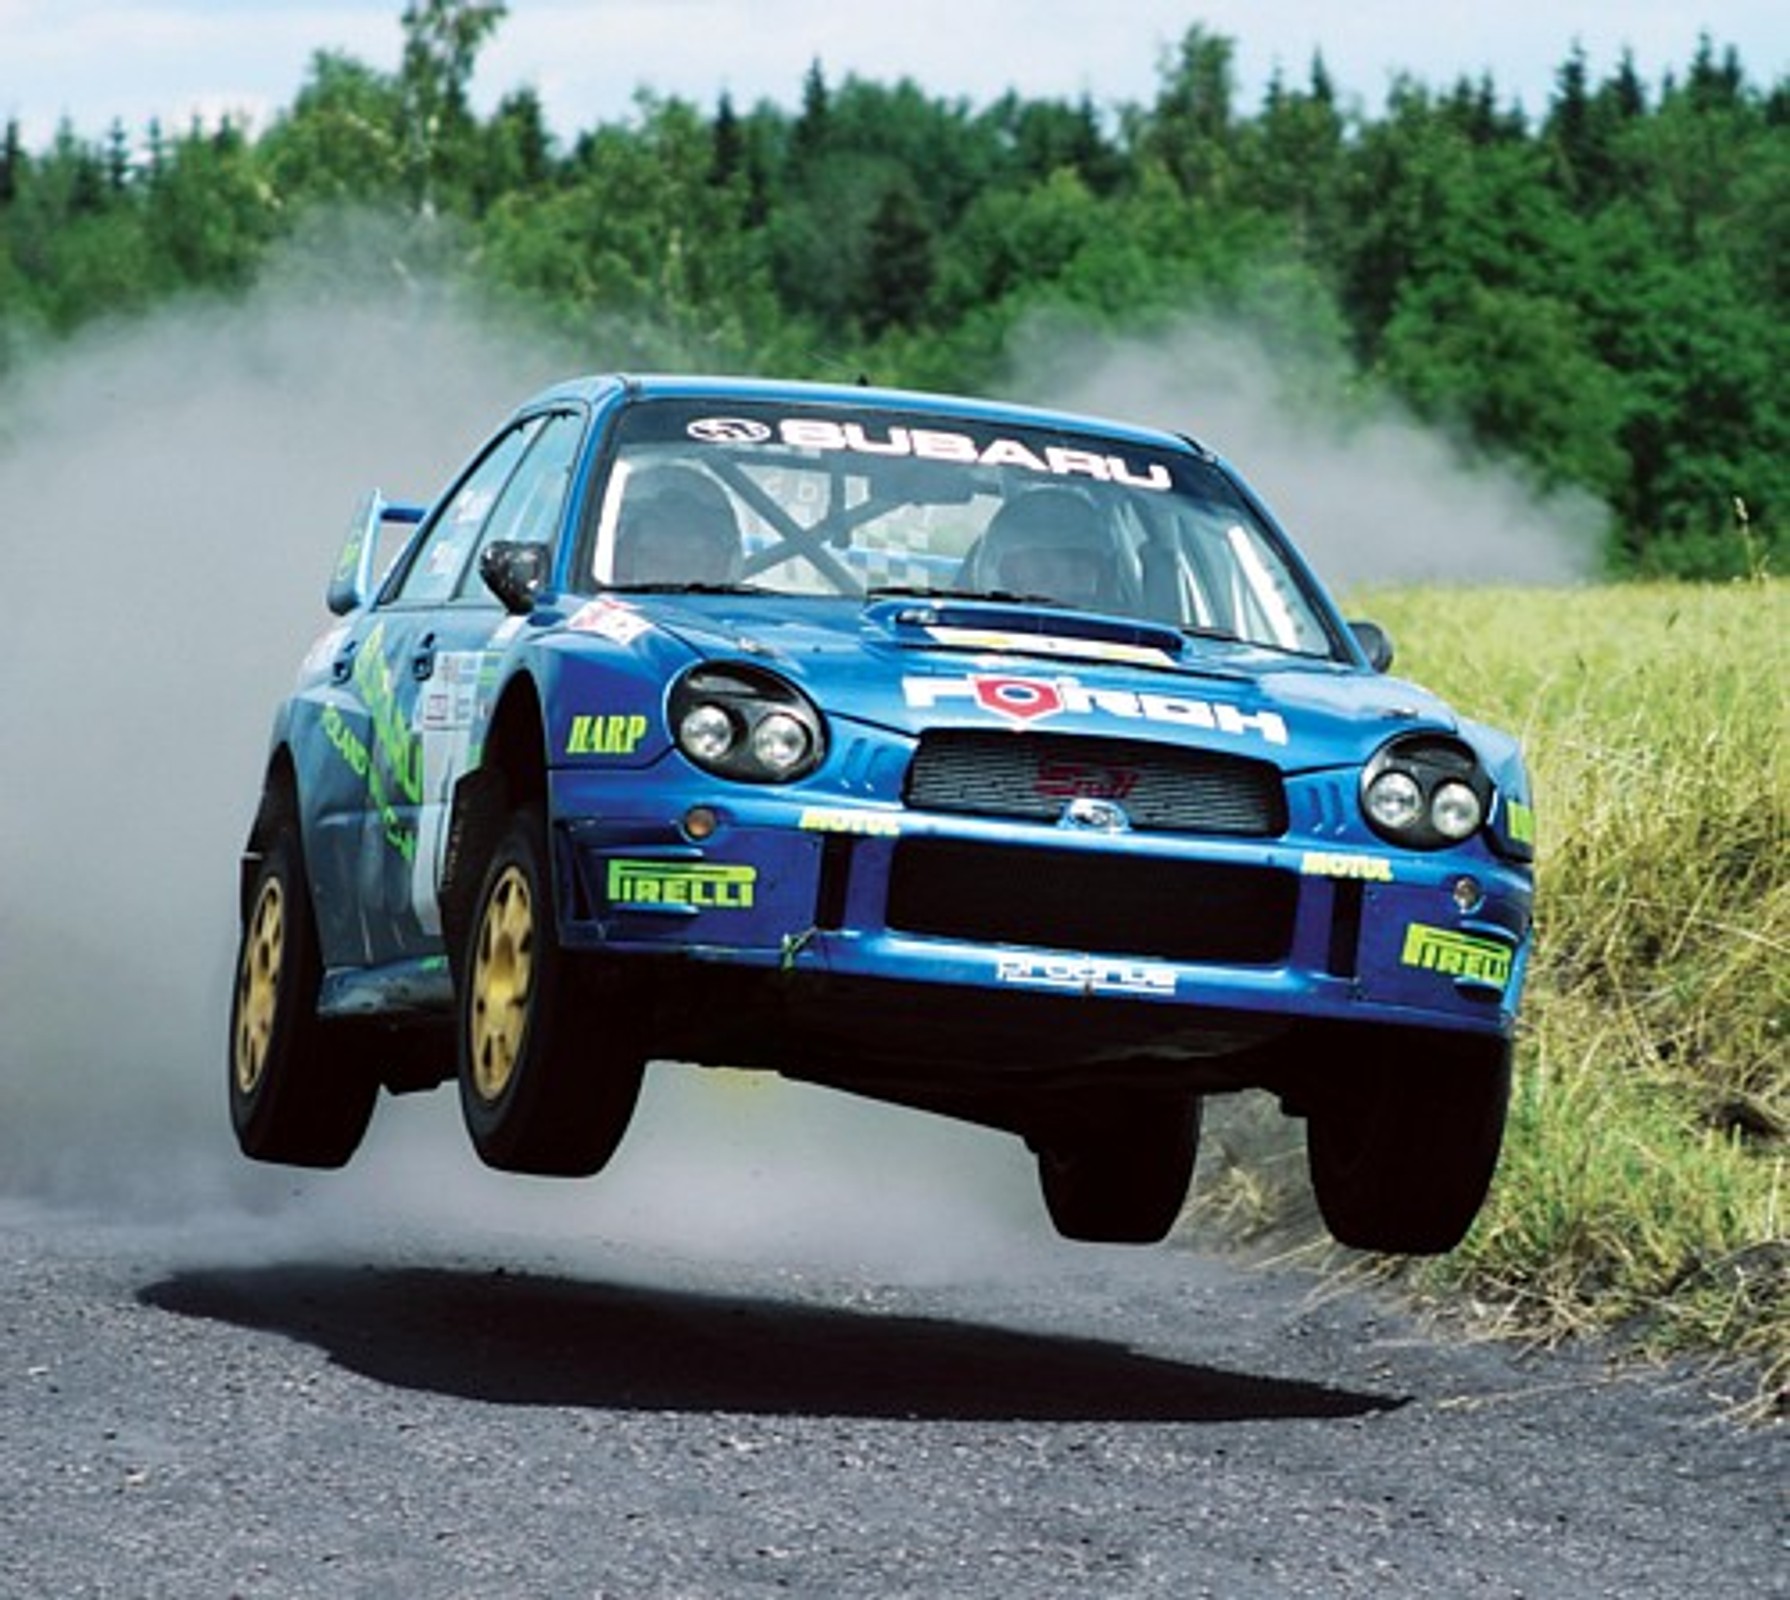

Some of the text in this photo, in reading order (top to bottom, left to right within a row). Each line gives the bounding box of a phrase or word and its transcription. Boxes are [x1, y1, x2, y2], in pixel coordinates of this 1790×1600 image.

[778, 418, 1172, 490] SUBARU
[566, 714, 648, 754] HARP
[608, 858, 757, 907] PIRELLI
